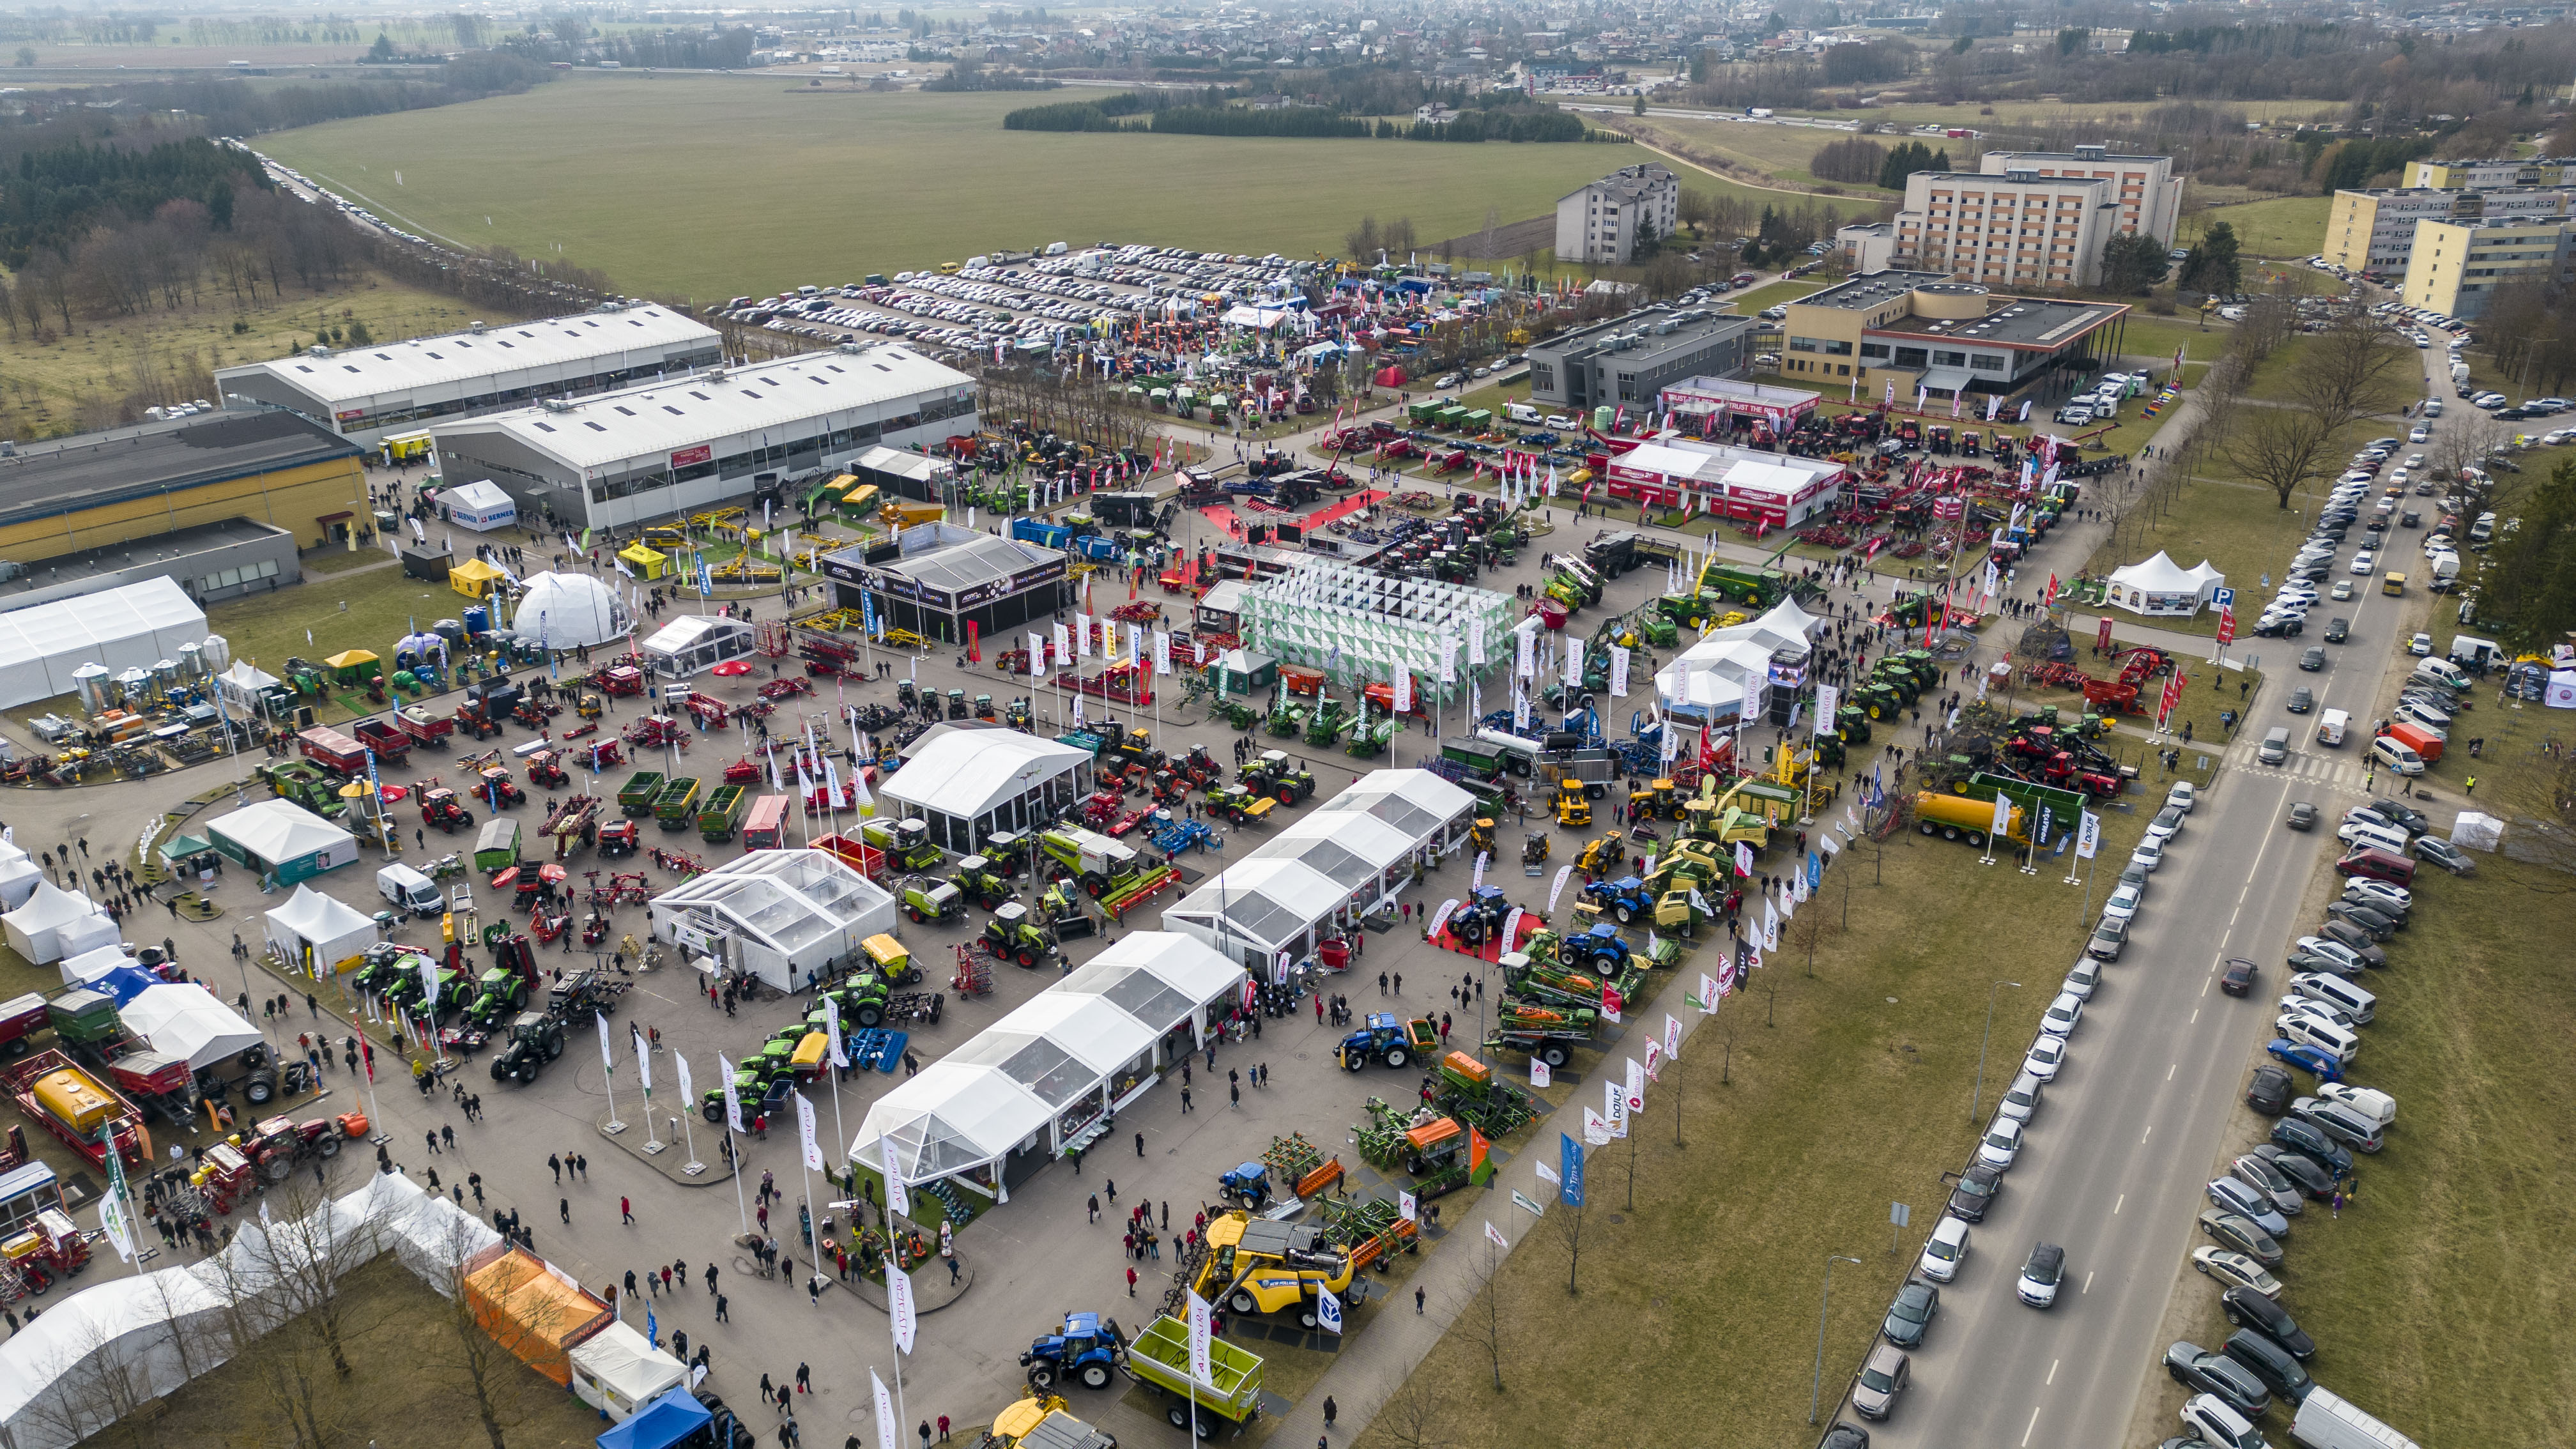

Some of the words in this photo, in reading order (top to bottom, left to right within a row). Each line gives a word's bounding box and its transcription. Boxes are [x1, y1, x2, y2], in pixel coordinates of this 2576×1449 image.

[1729, 402, 1748, 411] TRUST
[588, 470, 594, 479] 2
[456, 510, 478, 524] BERNER
[487, 510, 514, 522] BERNER
[696, 554, 704, 576] AGRA
[2218, 588, 2231, 602] P
[1219, 669, 1227, 698] McHale
[2040, 807, 2051, 843] KOMATSU
[2086, 816, 2095, 843] DOJUS
